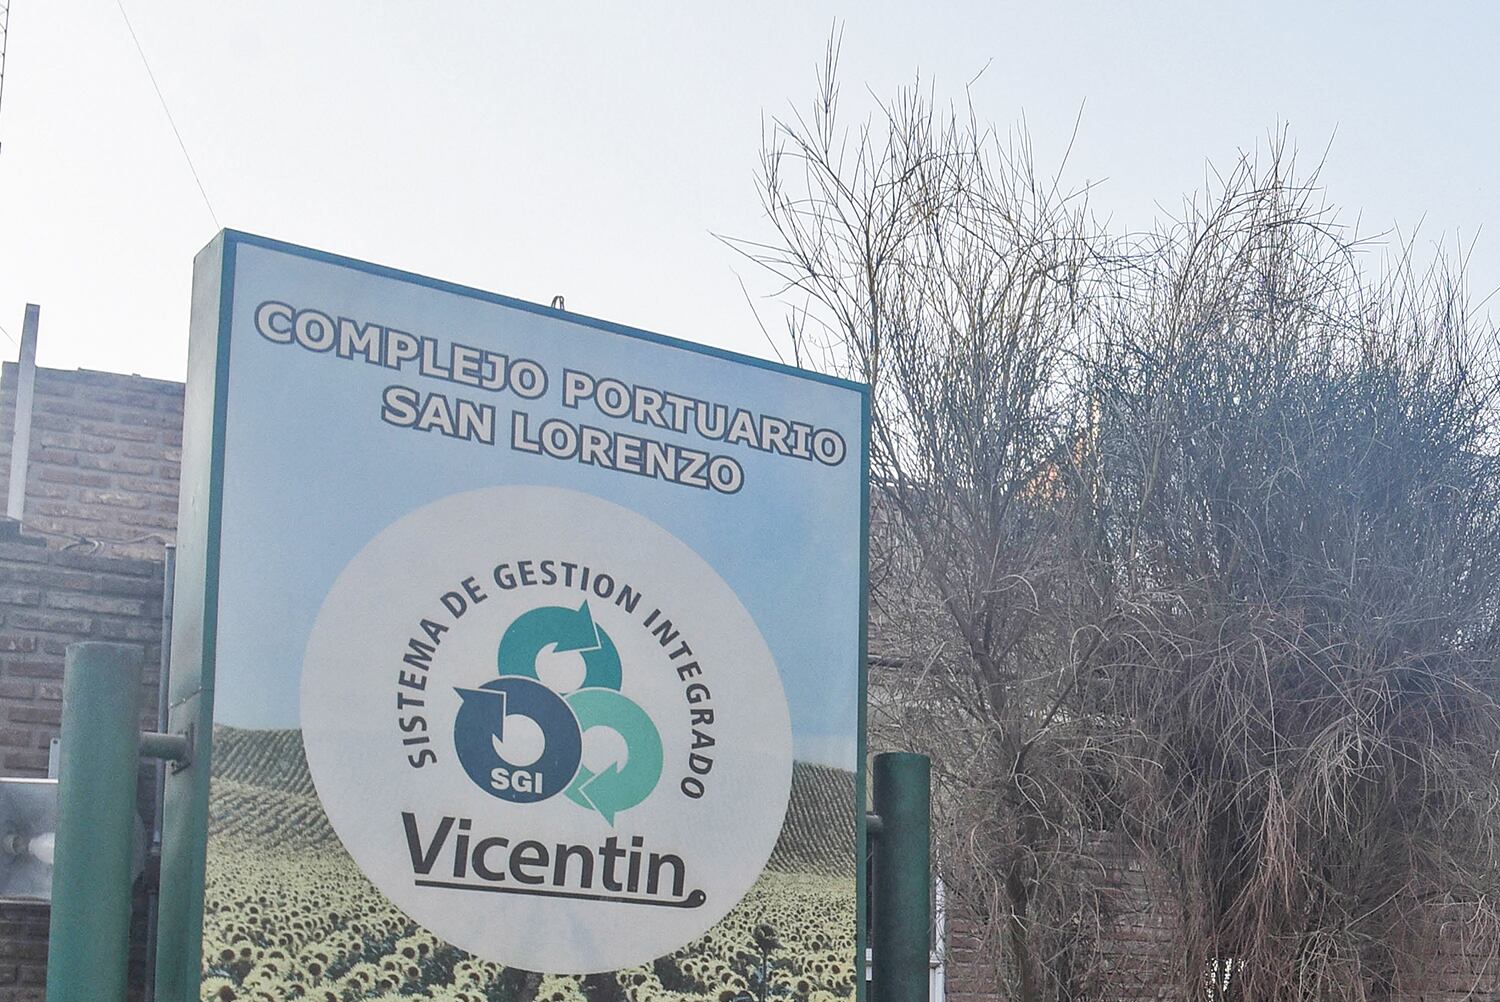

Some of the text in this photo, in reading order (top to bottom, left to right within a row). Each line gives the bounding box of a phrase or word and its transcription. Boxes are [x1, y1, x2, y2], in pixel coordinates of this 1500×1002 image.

[254, 300, 847, 467] COMPLEJO PORTUARIO
[381, 385, 745, 495] SAN LORENZO
[397, 560, 716, 800] SISTEMA DE GESTION INTEGRADO
[490, 767, 543, 794] SGI
[401, 811, 686, 897] Vicentin
